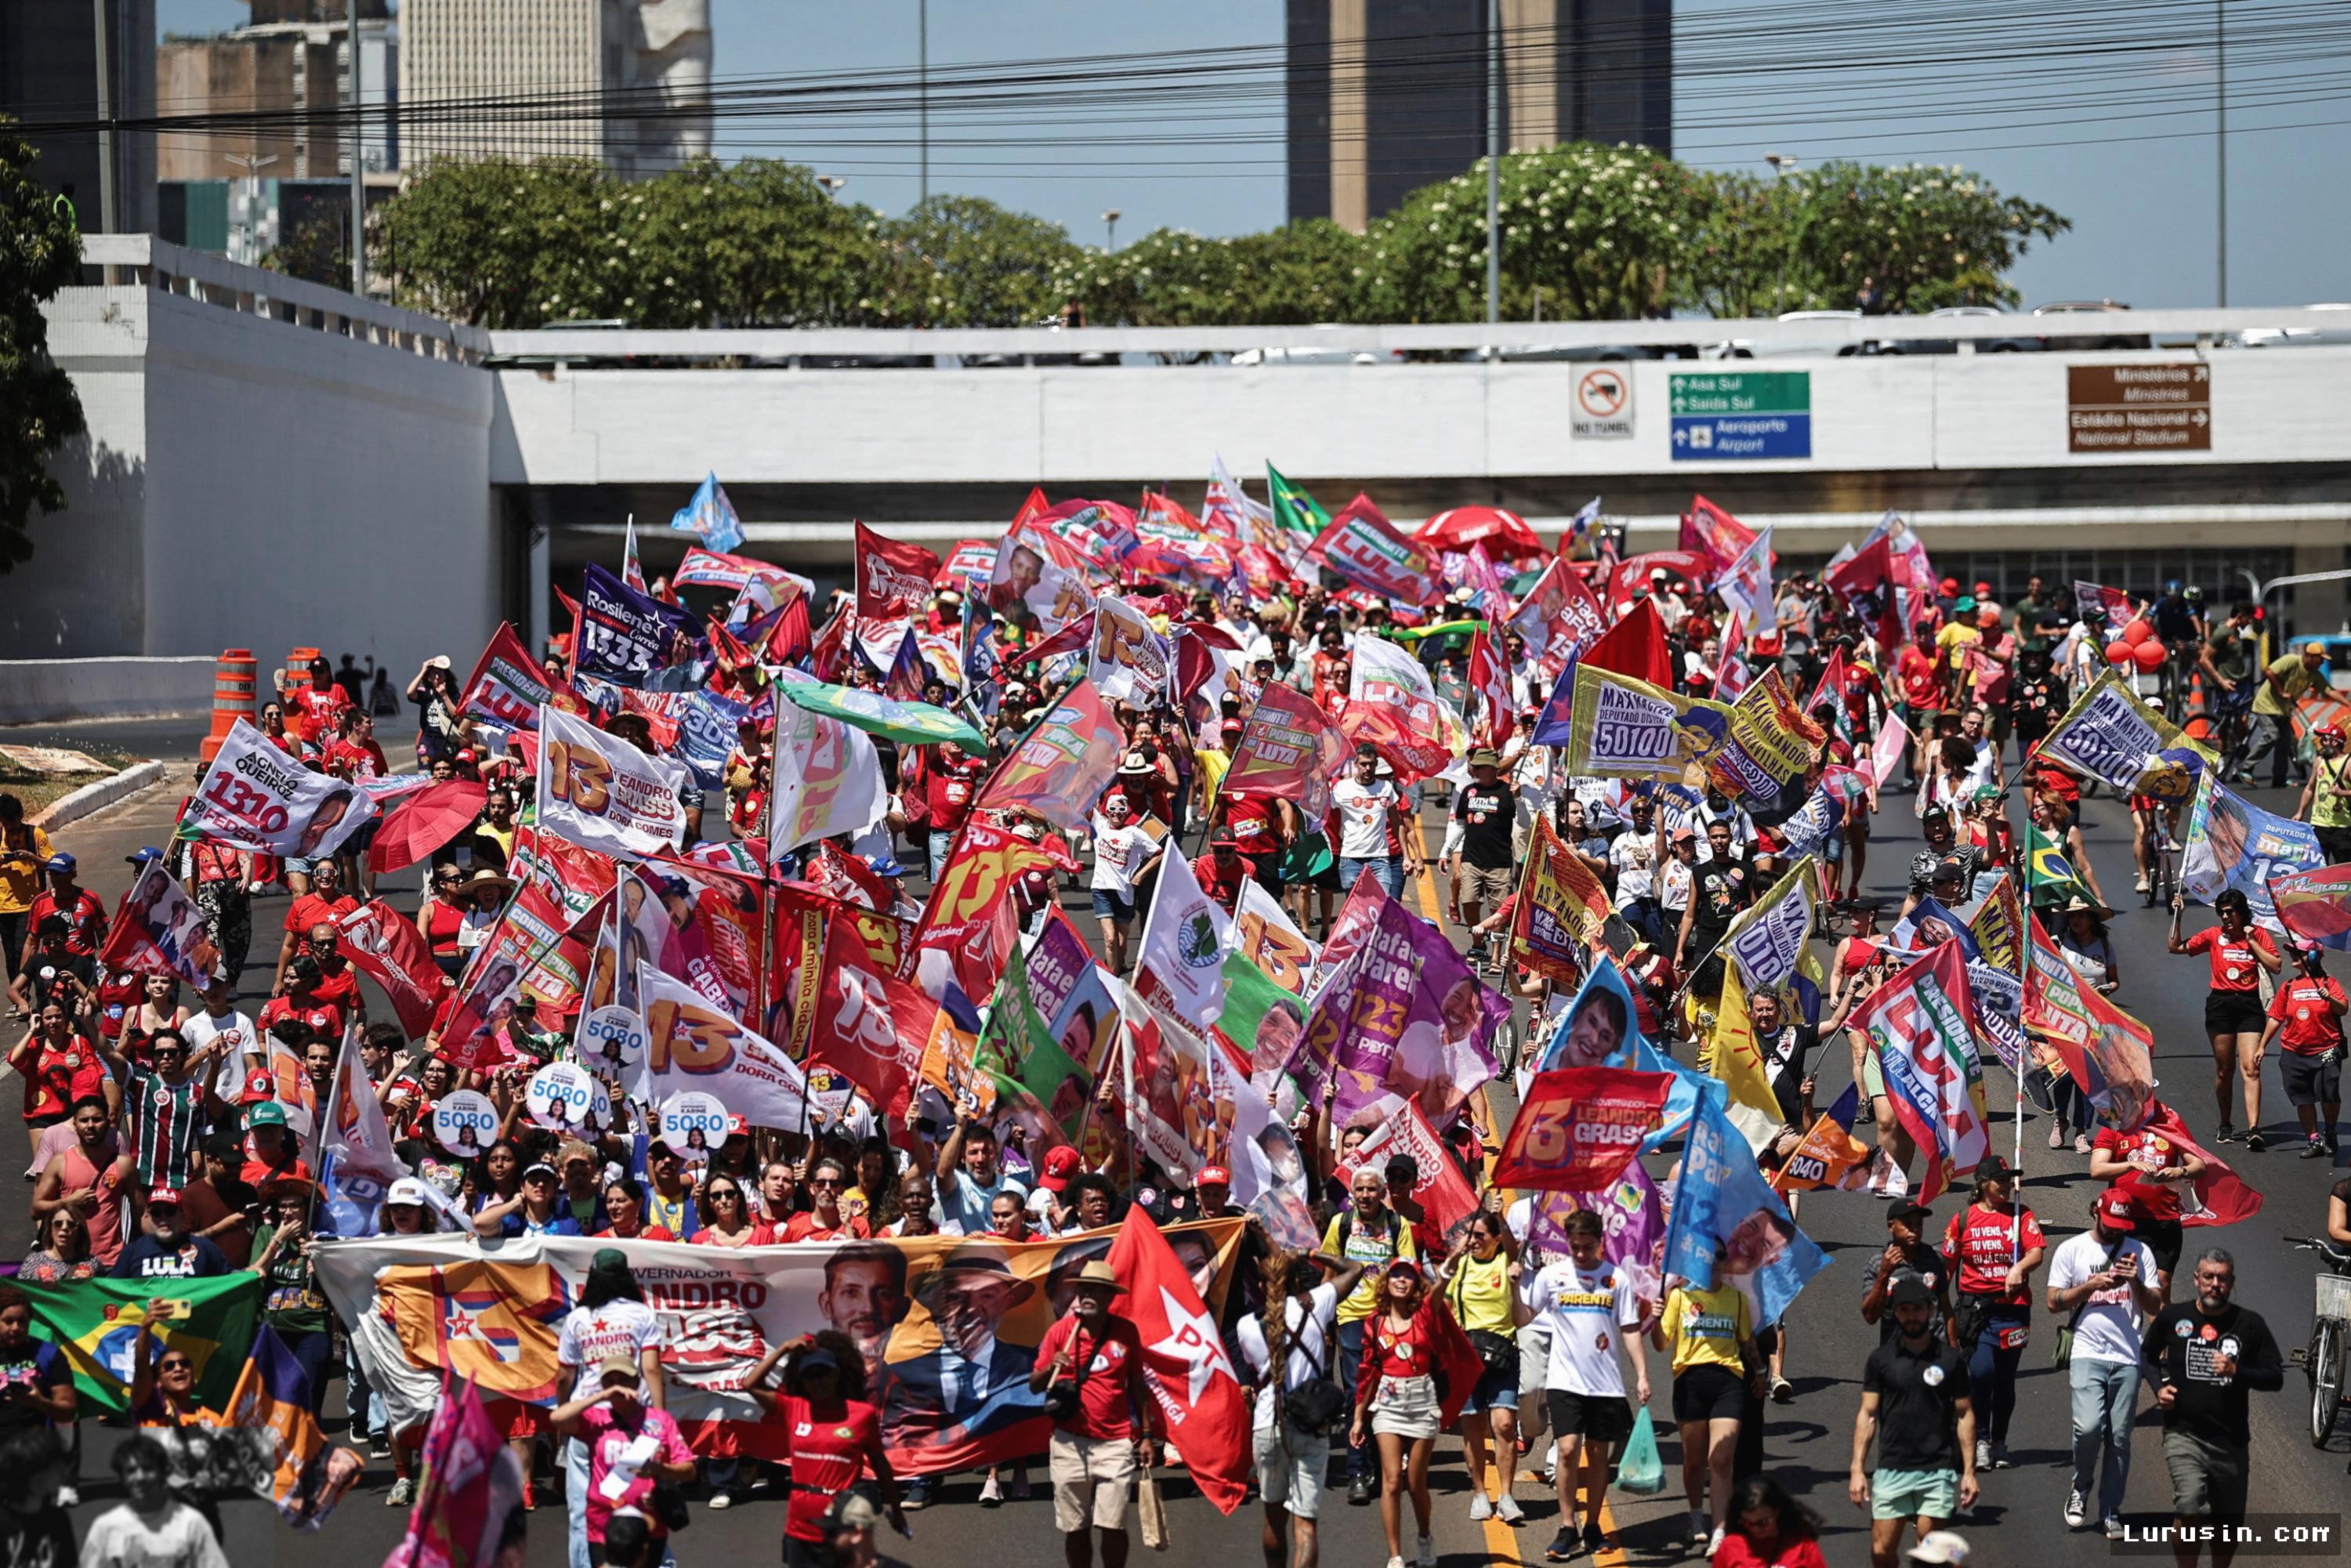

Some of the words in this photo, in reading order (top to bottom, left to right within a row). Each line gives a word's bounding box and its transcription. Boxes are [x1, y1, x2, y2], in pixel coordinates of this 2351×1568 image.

[1689, 377, 1715, 389] Asa
[1719, 376, 1741, 389] Sul
[2123, 386, 2190, 402] Ministries
[1732, 397, 1755, 409] Sul
[1572, 422, 1588, 434] NO
[1716, 419, 1788, 435] Aeroporto
[2071, 411, 2125, 428] Estádio
[2126, 409, 2189, 426] Nacional
[1716, 437, 1764, 452] Airport
[2074, 429, 2132, 446] National
[2132, 428, 2190, 445] Stadium
[587, 589, 654, 634] Rosilene
[585, 619, 654, 672] 1333
[629, 630, 660, 651] Corrêa
[475, 681, 534, 726] LUL
[1599, 709, 1639, 725] DEPUTADO
[2085, 708, 2117, 740] DEPUTADO
[1255, 741, 1301, 764] LUTA
[1597, 723, 1672, 758] 50100
[1736, 723, 1789, 783] MARAVILHAS
[2064, 722, 2140, 788] 50100
[235, 758, 294, 802] QUEIROZ
[245, 751, 299, 790] AGNELO
[614, 770, 674, 801] LEANDRO
[205, 771, 288, 835] 1310
[614, 785, 675, 821] GRASS
[1663, 790, 1692, 813] VOTE
[202, 807, 276, 855] FEDERAL
[608, 810, 633, 828] DORA
[1235, 824, 1258, 834] LULA
[2266, 824, 2306, 838] DEPUTADO
[918, 851, 989, 925] 13
[1372, 925, 1414, 963] Rafa
[802, 954, 817, 998] minha
[1031, 945, 1075, 991] Rafae
[686, 957, 737, 1019] GABR
[1351, 989, 1407, 1039] 123
[1918, 973, 1982, 1077] PRESIDENTE
[587, 1021, 643, 1049] 5080
[790, 1000, 810, 1056] cidade
[1882, 1046, 1908, 1077] VICE
[736, 1063, 776, 1088] DORA
[810, 1076, 831, 1092] 13
[533, 1080, 587, 1106] 5080
[1592, 1098, 1646, 1108] GOVERNADOR
[438, 1110, 494, 1130] 5080
[665, 1114, 723, 1132] 5080
[1577, 1106, 1660, 1125] LEANDRO
[1397, 1108, 1441, 1172] EANDRO
[151, 1189, 176, 1199] LULA
[1970, 1227, 1982, 1238] TU
[1982, 1226, 2003, 1238] VENS,
[1971, 1240, 1982, 1251] TU
[1982, 1240, 2005, 1251] VENS,
[142, 1255, 196, 1276] LULA
[625, 1266, 733, 1280] OVERNADOR
[627, 1281, 767, 1311] ANDRO
[1558, 1293, 1614, 1308] PARENTE
[455, 1320, 471, 1332] PT
[1682, 1316, 1735, 1331] PARENTE
[581, 1334, 633, 1349] EANDRO
[657, 1313, 767, 1364] ASS
[1174, 1322, 1224, 1368] PT
